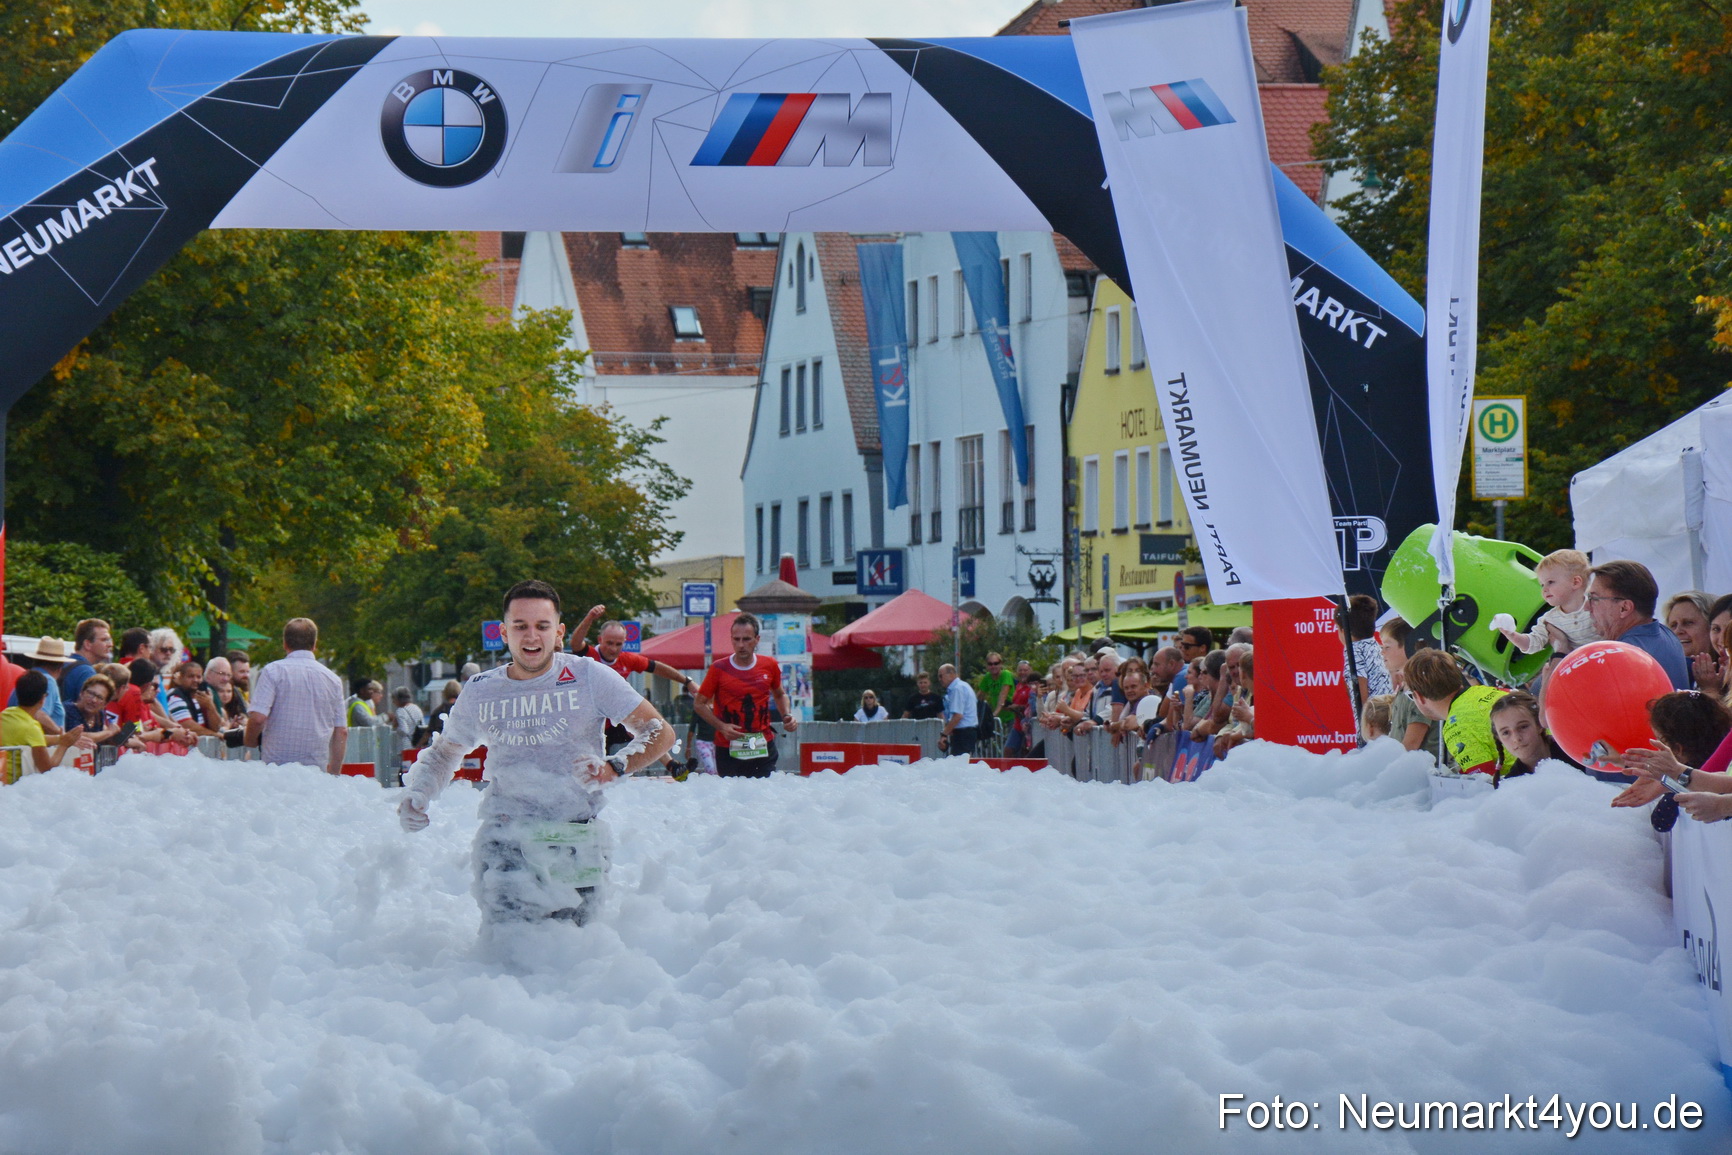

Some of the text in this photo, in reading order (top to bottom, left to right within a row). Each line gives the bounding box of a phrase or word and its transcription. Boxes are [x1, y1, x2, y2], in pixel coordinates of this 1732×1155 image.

[392, 69, 496, 105] BMW
[879, 345, 907, 408] K&L
[1120, 408, 1148, 439] HOTEL
[1488, 412, 1509, 435] H
[1482, 446, 1517, 455] Marktplatz
[1119, 565, 1158, 588] Restaurant
[1294, 621, 1315, 634] 100
[1295, 671, 1341, 687] BMW
[478, 689, 581, 723] ULTIMATE
[487, 717, 570, 747] CHAMPIONSHIP
[506, 716, 547, 729] FIGHTING
